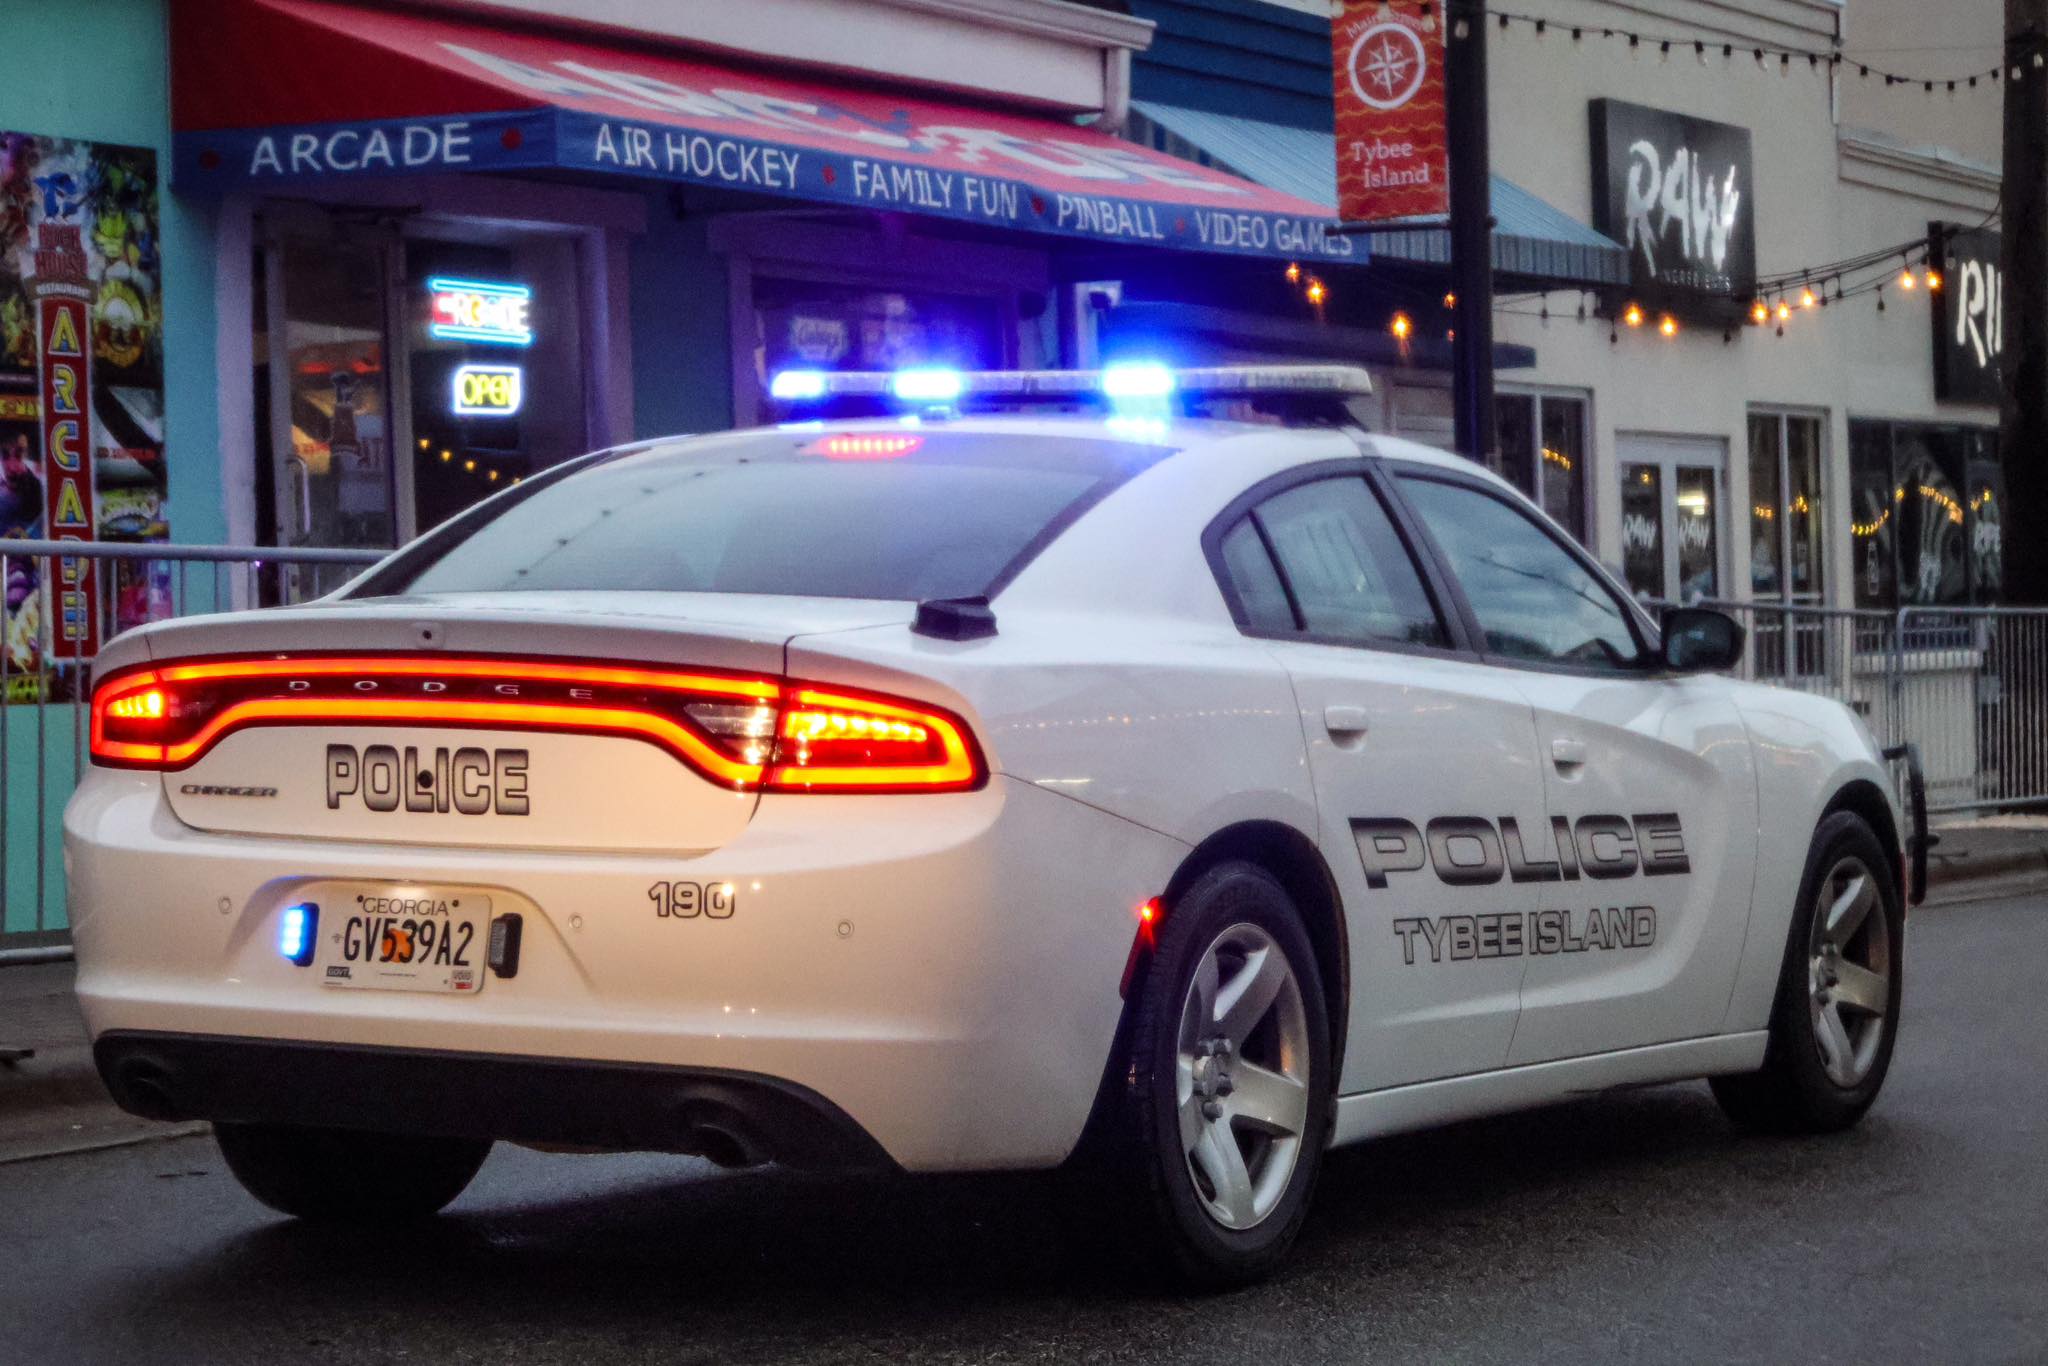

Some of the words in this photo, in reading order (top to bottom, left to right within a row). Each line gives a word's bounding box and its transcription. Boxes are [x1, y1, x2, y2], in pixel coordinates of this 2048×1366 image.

[250, 122, 471, 175] ARCADE
[595, 123, 657, 169] AIR
[665, 132, 800, 189] HOCKEY
[1350, 139, 1414, 165] Tybee
[852, 160, 953, 208] FAMILY
[963, 177, 1018, 220] FUN
[1363, 163, 1430, 188] Island
[1057, 193, 1165, 240] PINBALL
[1625, 139, 1740, 277] RAW
[1195, 210, 1269, 249] VIDEO
[1274, 218, 1353, 257] GAMES
[462, 373, 514, 406] OPEN
[288, 680, 593, 700] DODGE
[181, 784, 278, 797] CHARGER
[326, 743, 530, 816] POLICE
[1347, 812, 1692, 889] POLICE
[362, 897, 449, 916] GEORGIA
[648, 881, 735, 919] 190
[343, 916, 474, 967] GV539A2
[1393, 912, 1523, 965] TYBEE
[1528, 906, 1657, 955] ISLAND
